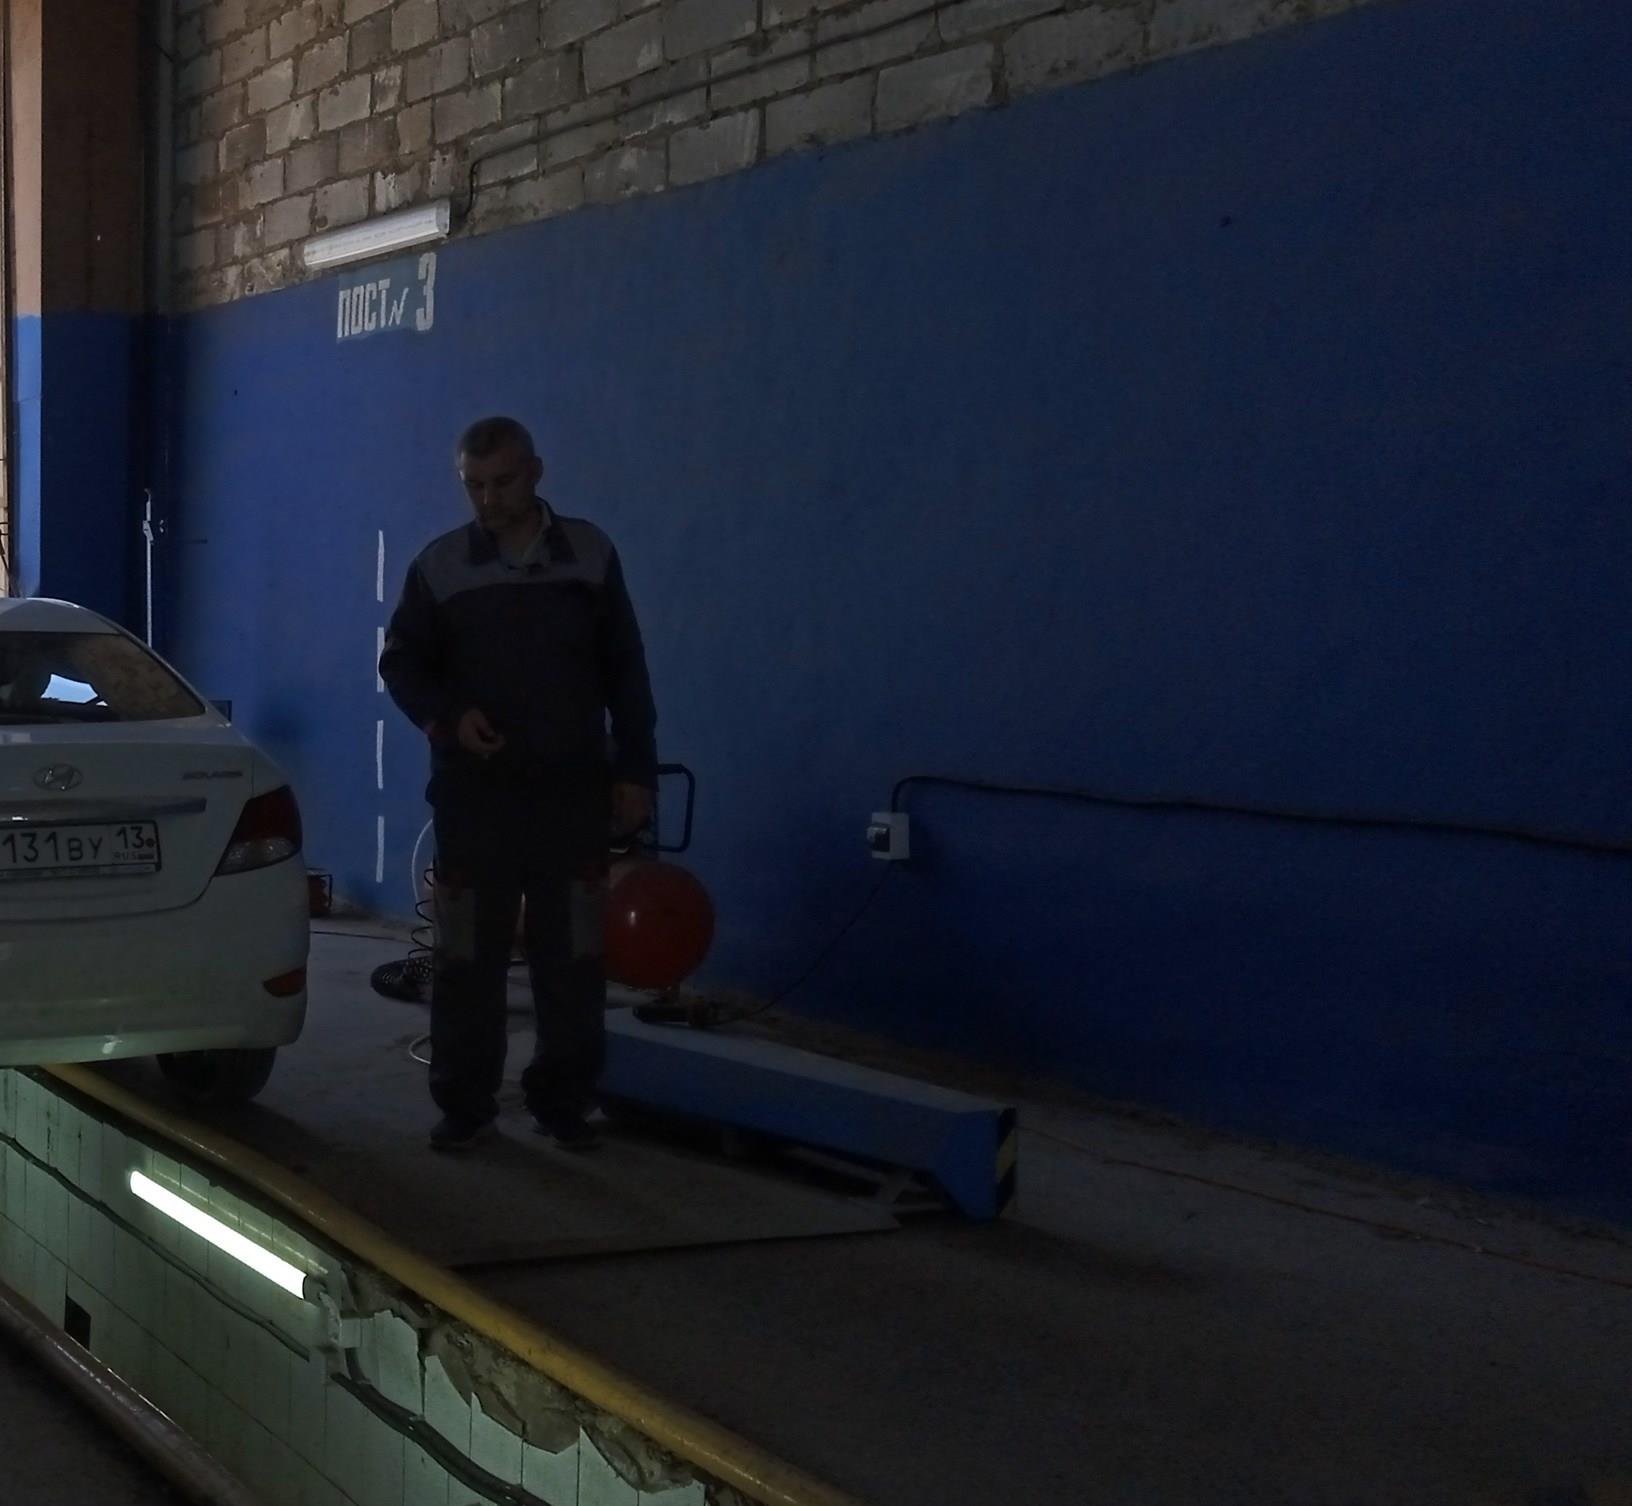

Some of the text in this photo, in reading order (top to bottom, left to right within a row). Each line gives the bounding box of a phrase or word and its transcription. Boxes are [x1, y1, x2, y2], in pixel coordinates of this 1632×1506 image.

[337, 279, 390, 338] ПОСТ
[416, 252, 437, 331] 3
[115, 825, 144, 849] 13
